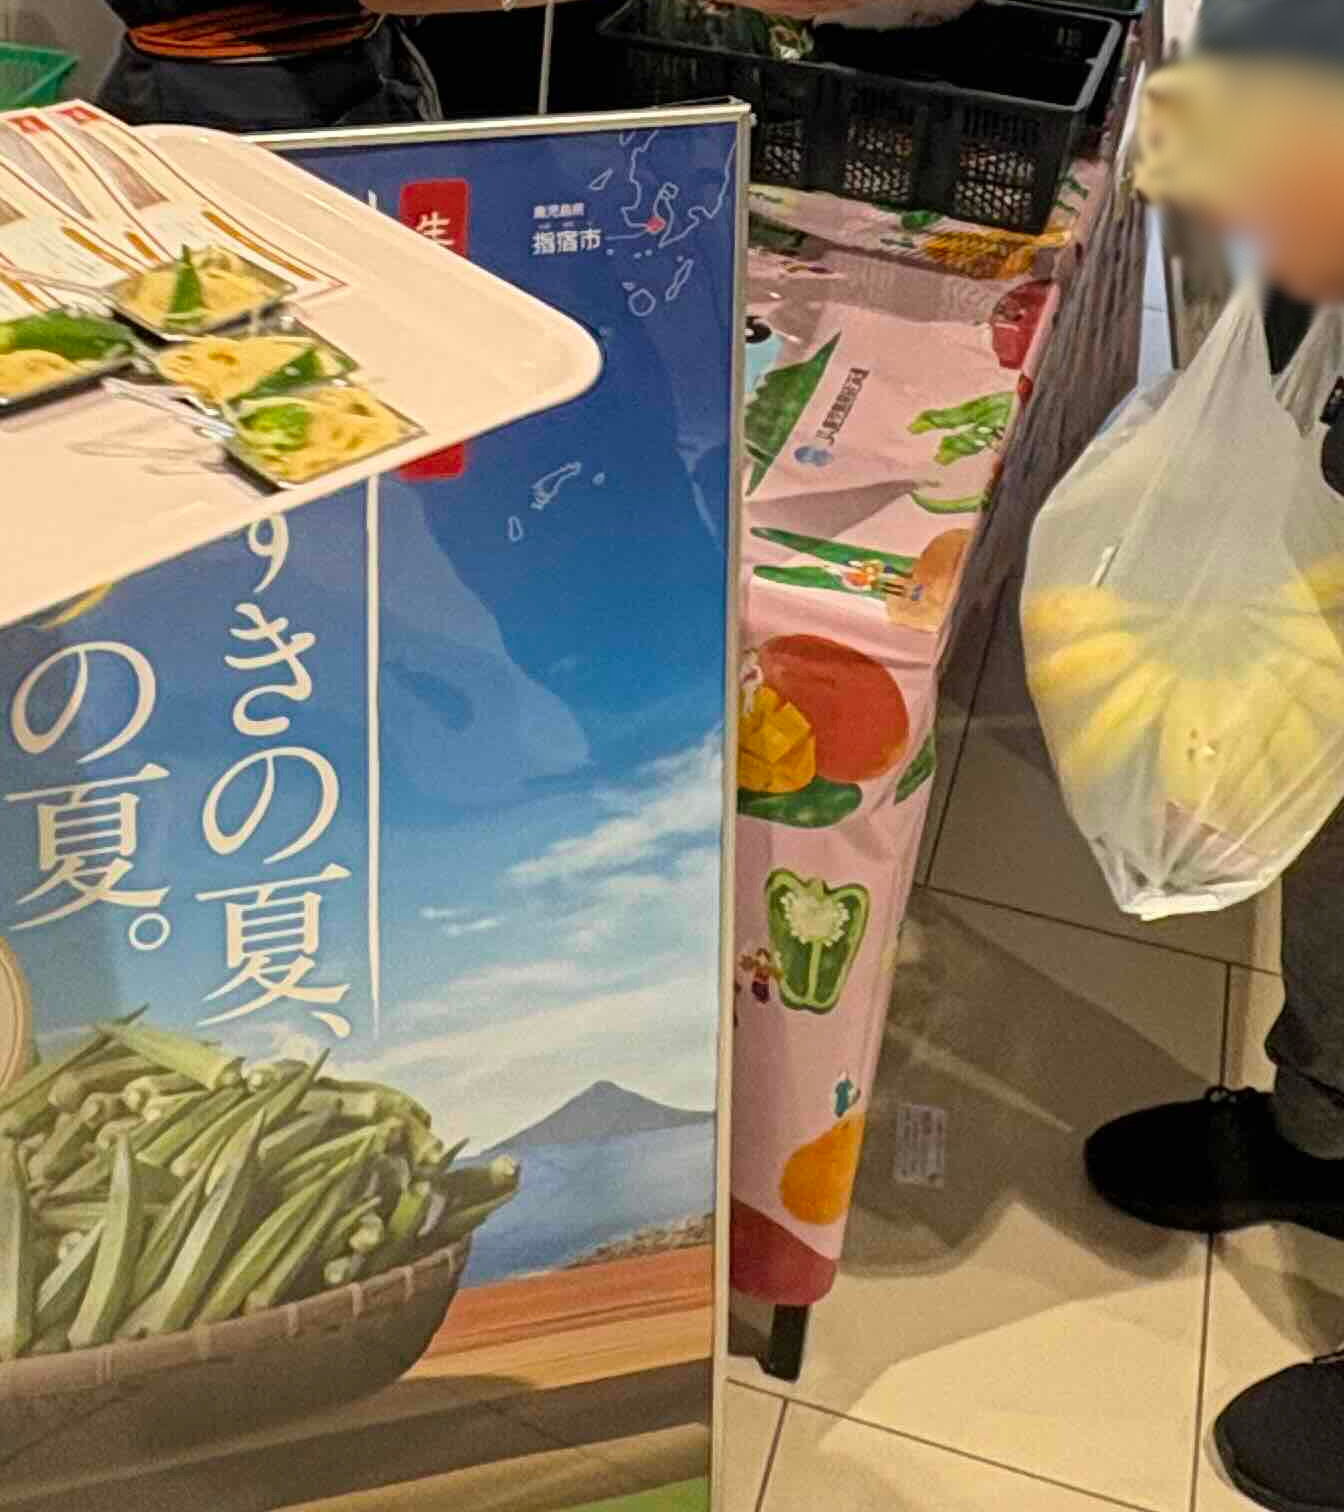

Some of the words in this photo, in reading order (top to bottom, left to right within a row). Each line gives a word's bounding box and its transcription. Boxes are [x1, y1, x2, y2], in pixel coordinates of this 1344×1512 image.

[532, 228, 602, 256] 指宿市
[3, 640, 171, 951] の夏。
